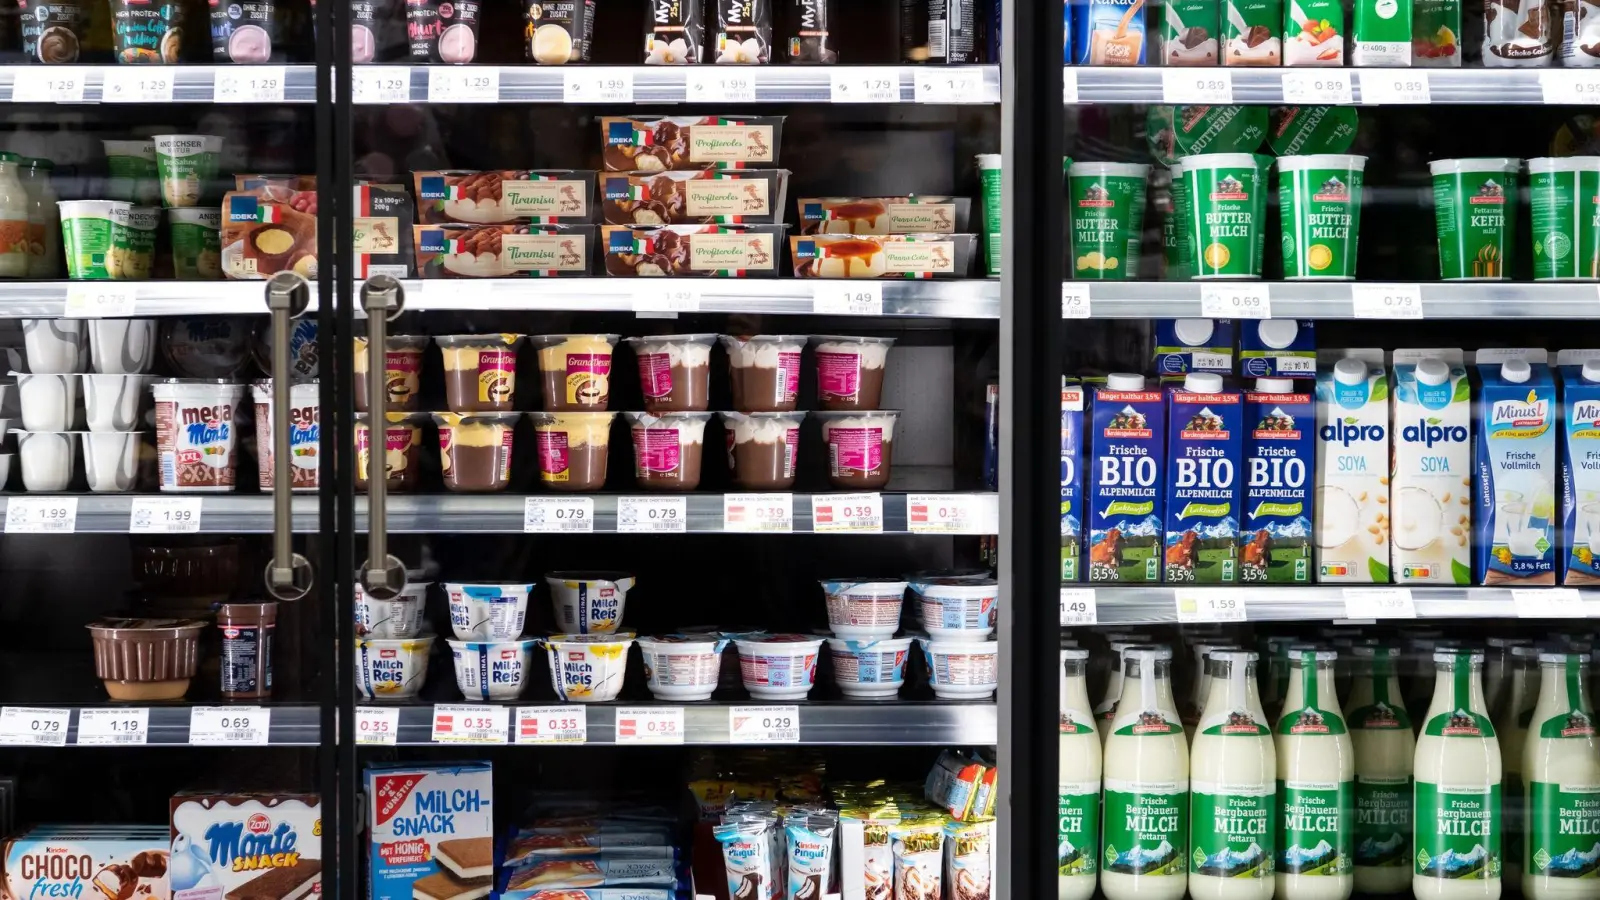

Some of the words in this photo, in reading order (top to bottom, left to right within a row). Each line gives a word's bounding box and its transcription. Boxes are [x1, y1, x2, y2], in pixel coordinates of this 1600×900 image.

[557, 3, 574, 11] ZUCKER
[1370, 45, 1387, 53] 400g
[48, 80, 74, 90] 1.29
[139, 80, 165, 90] 1.29
[249, 79, 276, 90] 1.29
[375, 79, 402, 90] 1.29
[463, 77, 489, 87] 1.29
[596, 79, 624, 89] 1.99
[719, 79, 746, 89] 1.99
[862, 79, 891, 90] 1.79
[1196, 80, 1224, 90] 0.89
[1315, 81, 1343, 91] 0.89
[1394, 81, 1422, 91] 0.89
[695, 138, 743, 150] Profiteroles
[507, 192, 555, 206] Tiramisu
[691, 193, 738, 204] Profiteroles
[891, 215, 912, 224] Panna
[1206, 213, 1252, 224] BUTTER
[1308, 213, 1353, 225] BUTTER
[1471, 215, 1505, 227] KEFIR
[1076, 219, 1118, 230] BUTTER
[1079, 231, 1114, 242] MILCH
[1210, 226, 1248, 237] MILCH
[1312, 227, 1349, 239] MILCH
[507, 247, 555, 260] Tiramisu
[695, 246, 743, 258] Profiteroles
[844, 292, 872, 302] 1.49
[1232, 296, 1260, 306] 0.69
[1384, 295, 1412, 306] 0.79
[481, 354, 502, 364] Grand
[568, 357, 593, 366] Grand
[1099, 393, 1123, 401] länger
[1176, 395, 1200, 403] länger
[1247, 395, 1271, 403] länger
[181, 404, 230, 424] mega
[1496, 402, 1544, 421] MinusL
[187, 423, 229, 446] Monte
[1319, 419, 1384, 447] alpro
[1402, 419, 1467, 447] alpro
[1109, 445, 1147, 455] Frische
[1186, 447, 1225, 457] Frische
[1257, 446, 1296, 456] Frische
[1506, 451, 1536, 460] Frische
[178, 452, 200, 462] XXL
[1338, 456, 1366, 471] SOYA
[1420, 456, 1449, 472] SOYA
[1500, 461, 1541, 470] Vollmilch
[1099, 456, 1157, 486] BIO
[1175, 458, 1233, 488] BIO
[1248, 458, 1305, 488] BIO
[1099, 487, 1156, 497] ALPENMILCH
[1175, 489, 1232, 499] ALPENMILCH
[1248, 488, 1304, 498] ALPENMILCH
[39, 508, 67, 519] 1.99
[163, 510, 191, 520] 1.99
[556, 508, 584, 519] 0.79
[648, 508, 677, 519] 0.79
[755, 507, 783, 518] 0.39
[843, 506, 872, 517] 0.39
[1513, 562, 1526, 570] 3,8
[1535, 562, 1550, 570] Fett
[1092, 568, 1118, 581] 3,5%
[1168, 568, 1194, 581] 3,5%
[1241, 568, 1267, 581] 3,5%
[591, 598, 617, 607] Milch
[1208, 599, 1235, 610] 1.59
[591, 608, 617, 620] Reis
[372, 660, 403, 670] Milch
[492, 660, 520, 670] Milch
[563, 662, 592, 672] Milch
[373, 670, 402, 682] Reis
[492, 670, 520, 684] Reis
[565, 672, 592, 685] Reis
[31, 720, 60, 731] 0.79
[110, 720, 138, 731] 1.19
[221, 717, 249, 728] 0.69
[360, 720, 388, 731] 0.35
[463, 718, 492, 729] 0.35
[548, 719, 577, 730] 0.35
[647, 720, 675, 731] 0.35
[762, 717, 790, 728] 0.29
[377, 778, 395, 797] GUT
[381, 779, 414, 815] GÜNSTIG
[1140, 797, 1167, 805] Frische
[1228, 798, 1256, 807] Frische
[1297, 796, 1325, 805] Frische
[1284, 804, 1337, 816] Bergbauern
[1451, 800, 1479, 809] Frische
[1125, 805, 1178, 817] Bergbauern
[1214, 806, 1266, 817] Bergbauern
[1436, 808, 1491, 819] Bergbauern
[392, 815, 455, 836] SNACK
[1125, 816, 1178, 832] MILCH
[1214, 817, 1266, 834] MILCH
[1284, 815, 1338, 832] MILCH
[1437, 819, 1491, 836] MILCH
[1138, 833, 1167, 841] fettarm
[1227, 834, 1256, 843] fettarm
[204, 821, 296, 867] Monte
[794, 848, 820, 858] Pingui
[231, 852, 300, 872] SNACK
[388, 855, 422, 864] VERFEINERT
[21, 854, 92, 880] CHOCO
[30, 876, 84, 900] fresh
